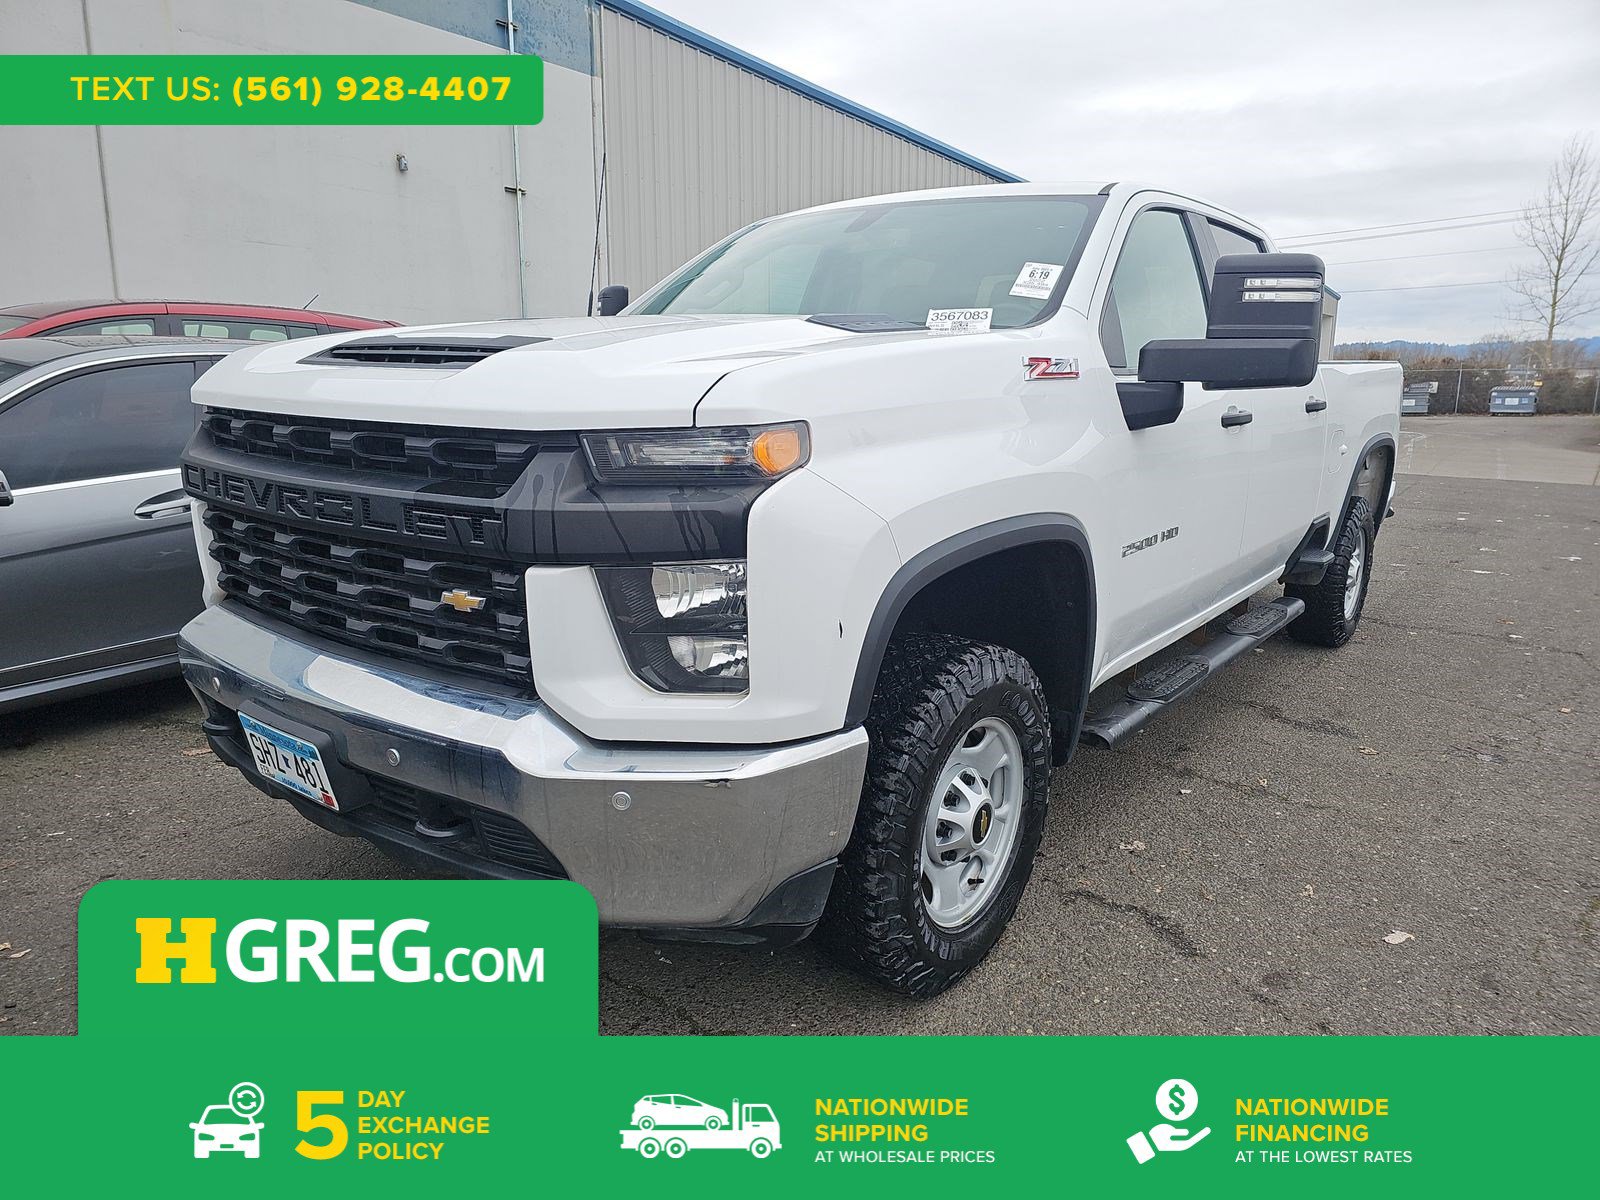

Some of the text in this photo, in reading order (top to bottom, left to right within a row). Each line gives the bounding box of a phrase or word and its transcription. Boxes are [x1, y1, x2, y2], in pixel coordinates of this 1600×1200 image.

[1028, 270, 1050, 280] 6:19
[930, 310, 989, 322] 3567083
[1022, 356, 1080, 381] Z71
[184, 463, 502, 545] CHEVROLET
[1121, 526, 1179, 558] 2500 HD
[249, 732, 287, 774] SHZ
[293, 754, 329, 794] 481
